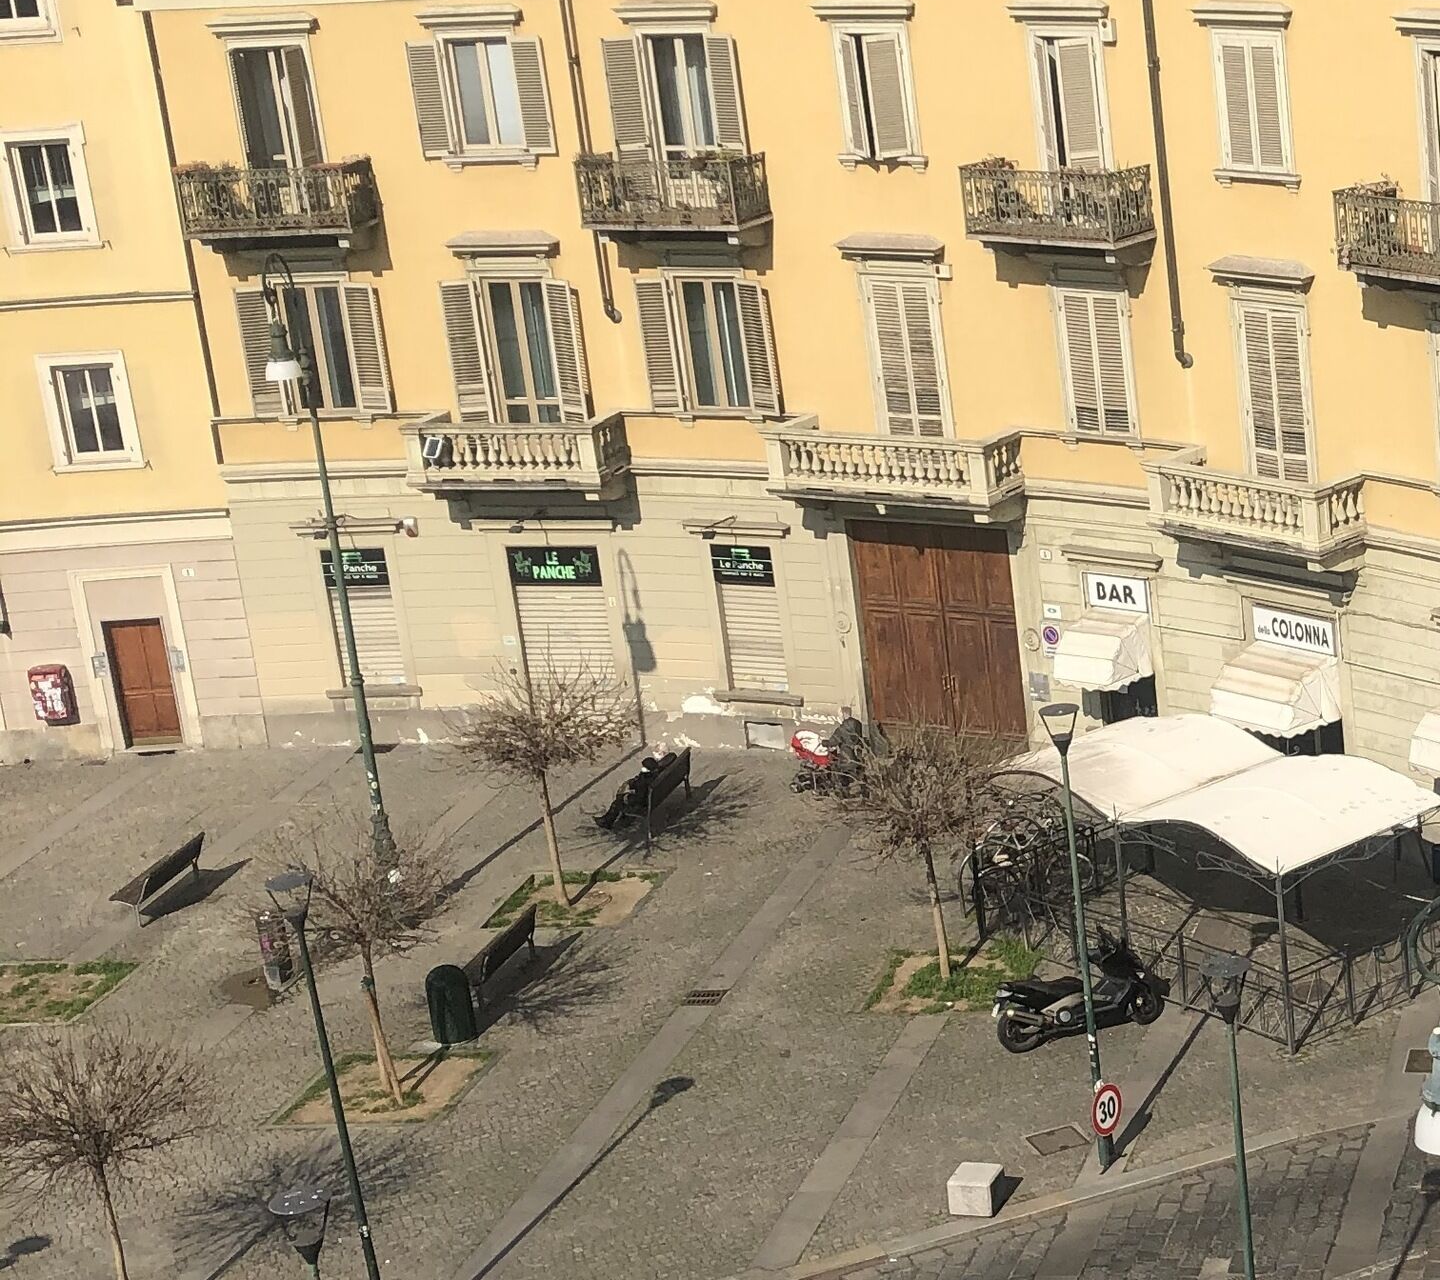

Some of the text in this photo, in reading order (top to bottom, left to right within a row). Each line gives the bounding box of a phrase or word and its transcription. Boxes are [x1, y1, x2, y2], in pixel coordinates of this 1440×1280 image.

[545, 551, 560, 565] LE
[719, 560, 764, 570] Le Panche
[343, 563, 378, 572] Panche
[532, 565, 577, 579] PANCHE
[1096, 582, 1136, 605] BAR
[1271, 617, 1330, 649] COLONNA
[1099, 1095, 1116, 1124] 30
